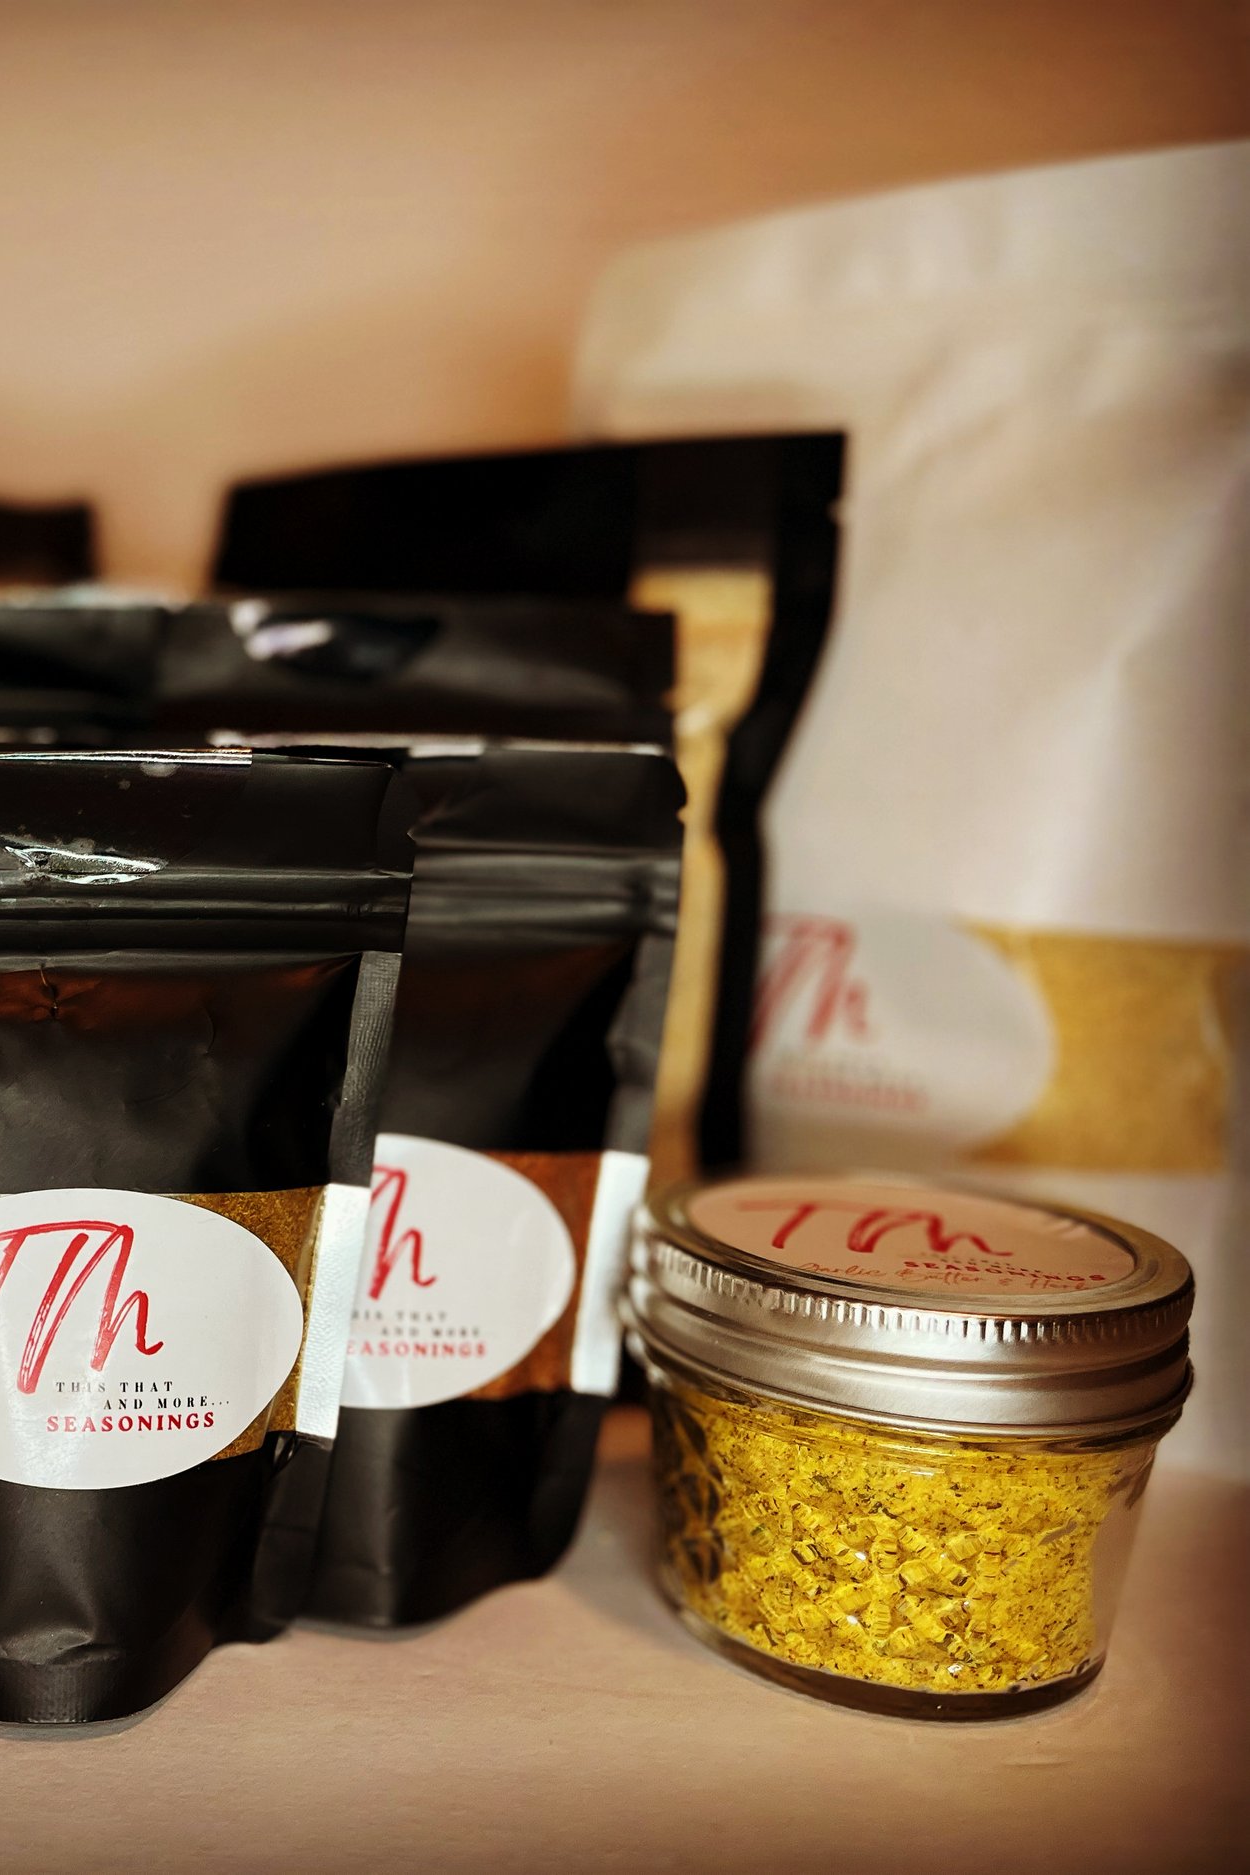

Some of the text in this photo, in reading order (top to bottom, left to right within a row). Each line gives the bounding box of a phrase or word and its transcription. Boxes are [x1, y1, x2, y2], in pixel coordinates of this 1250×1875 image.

[904, 1261, 1106, 1281] SEASONINGS
[347, 1341, 487, 1359] EASONINGS
[55, 1381, 174, 1393] THIS THAT
[103, 1398, 144, 1410] AND
[46, 1412, 215, 1433] SEASONINGS
